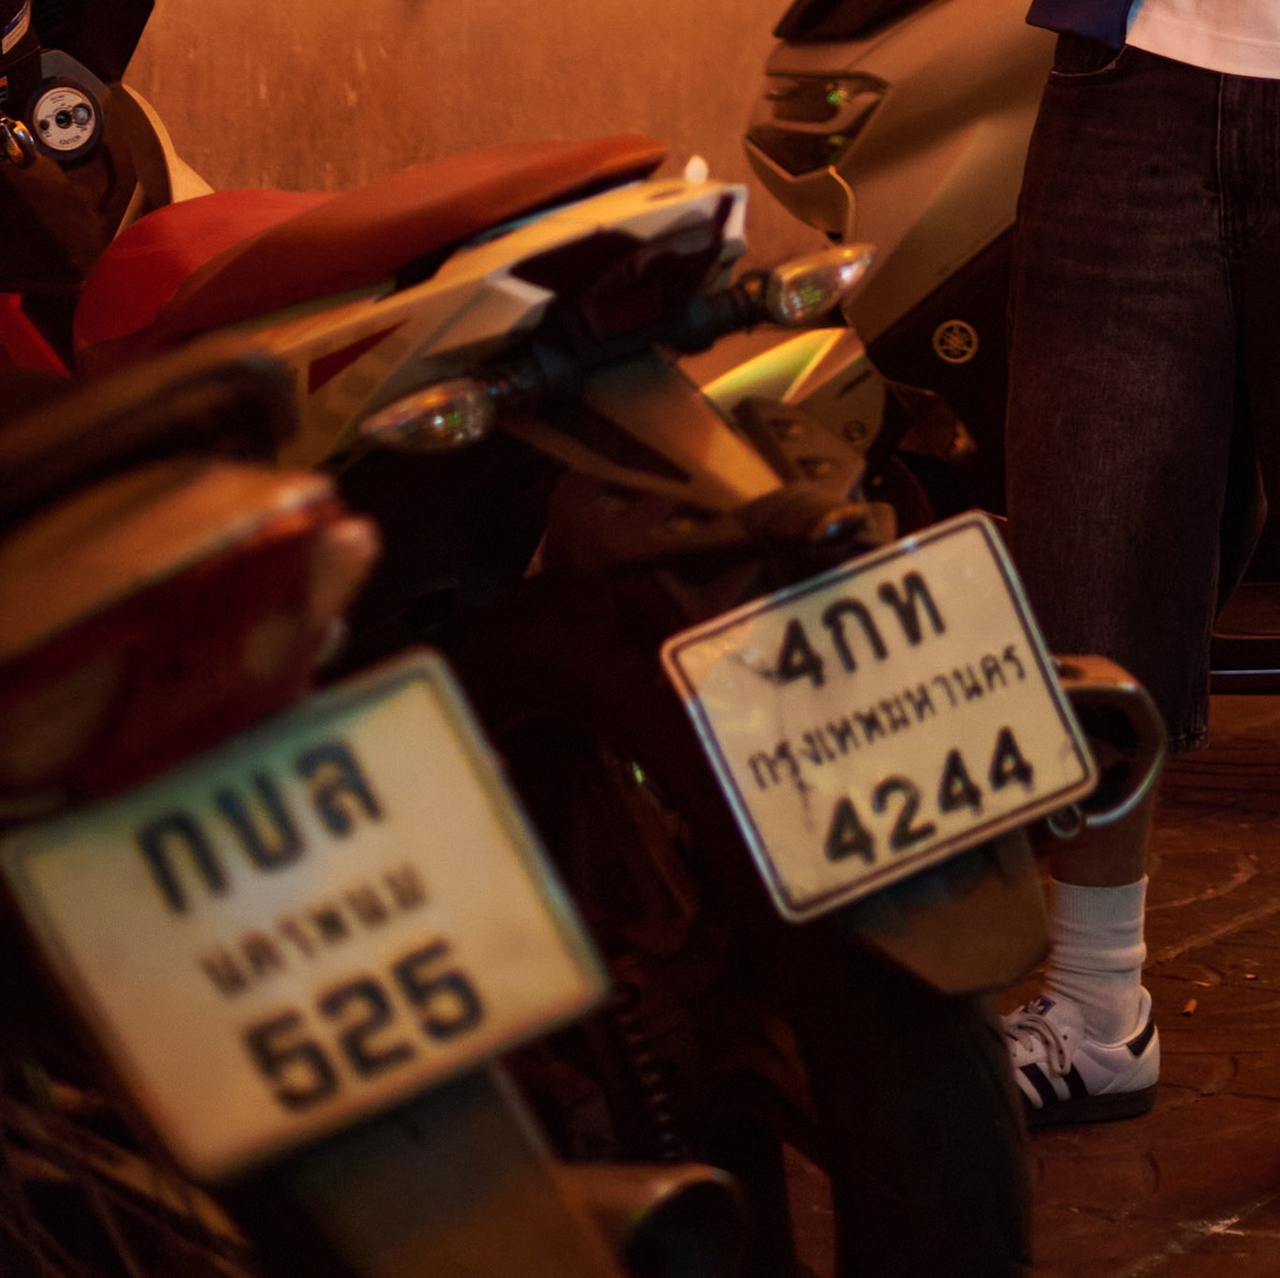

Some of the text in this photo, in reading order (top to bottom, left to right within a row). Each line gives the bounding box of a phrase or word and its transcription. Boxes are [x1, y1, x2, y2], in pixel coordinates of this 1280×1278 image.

[773, 570, 947, 689] 4กท
[747, 644, 1026, 791] กรุงเทพมหานคร
[823, 725, 1035, 866] 4244
[242, 934, 488, 1116] 525
